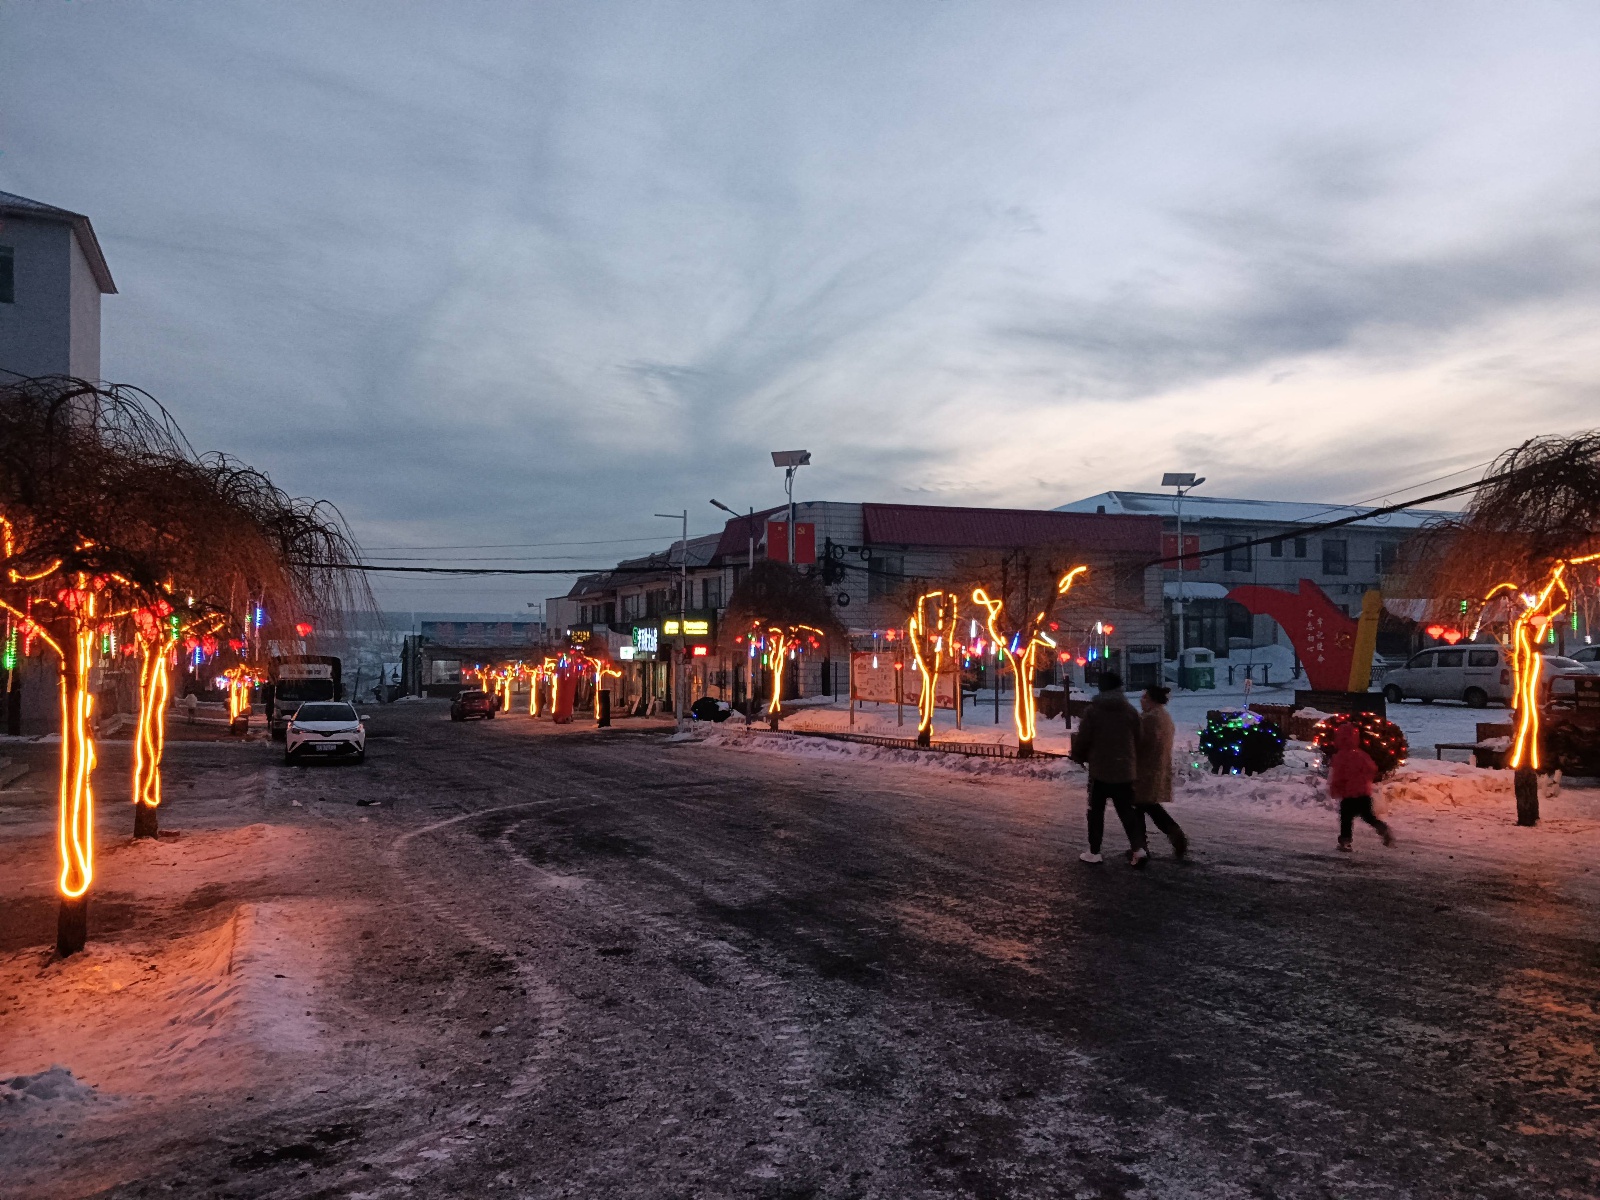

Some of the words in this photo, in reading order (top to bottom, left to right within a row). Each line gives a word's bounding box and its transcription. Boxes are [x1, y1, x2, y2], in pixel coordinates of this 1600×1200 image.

[1306, 609, 1315, 652] 不忘初心
[1316, 617, 1325, 663] 牢记使命
